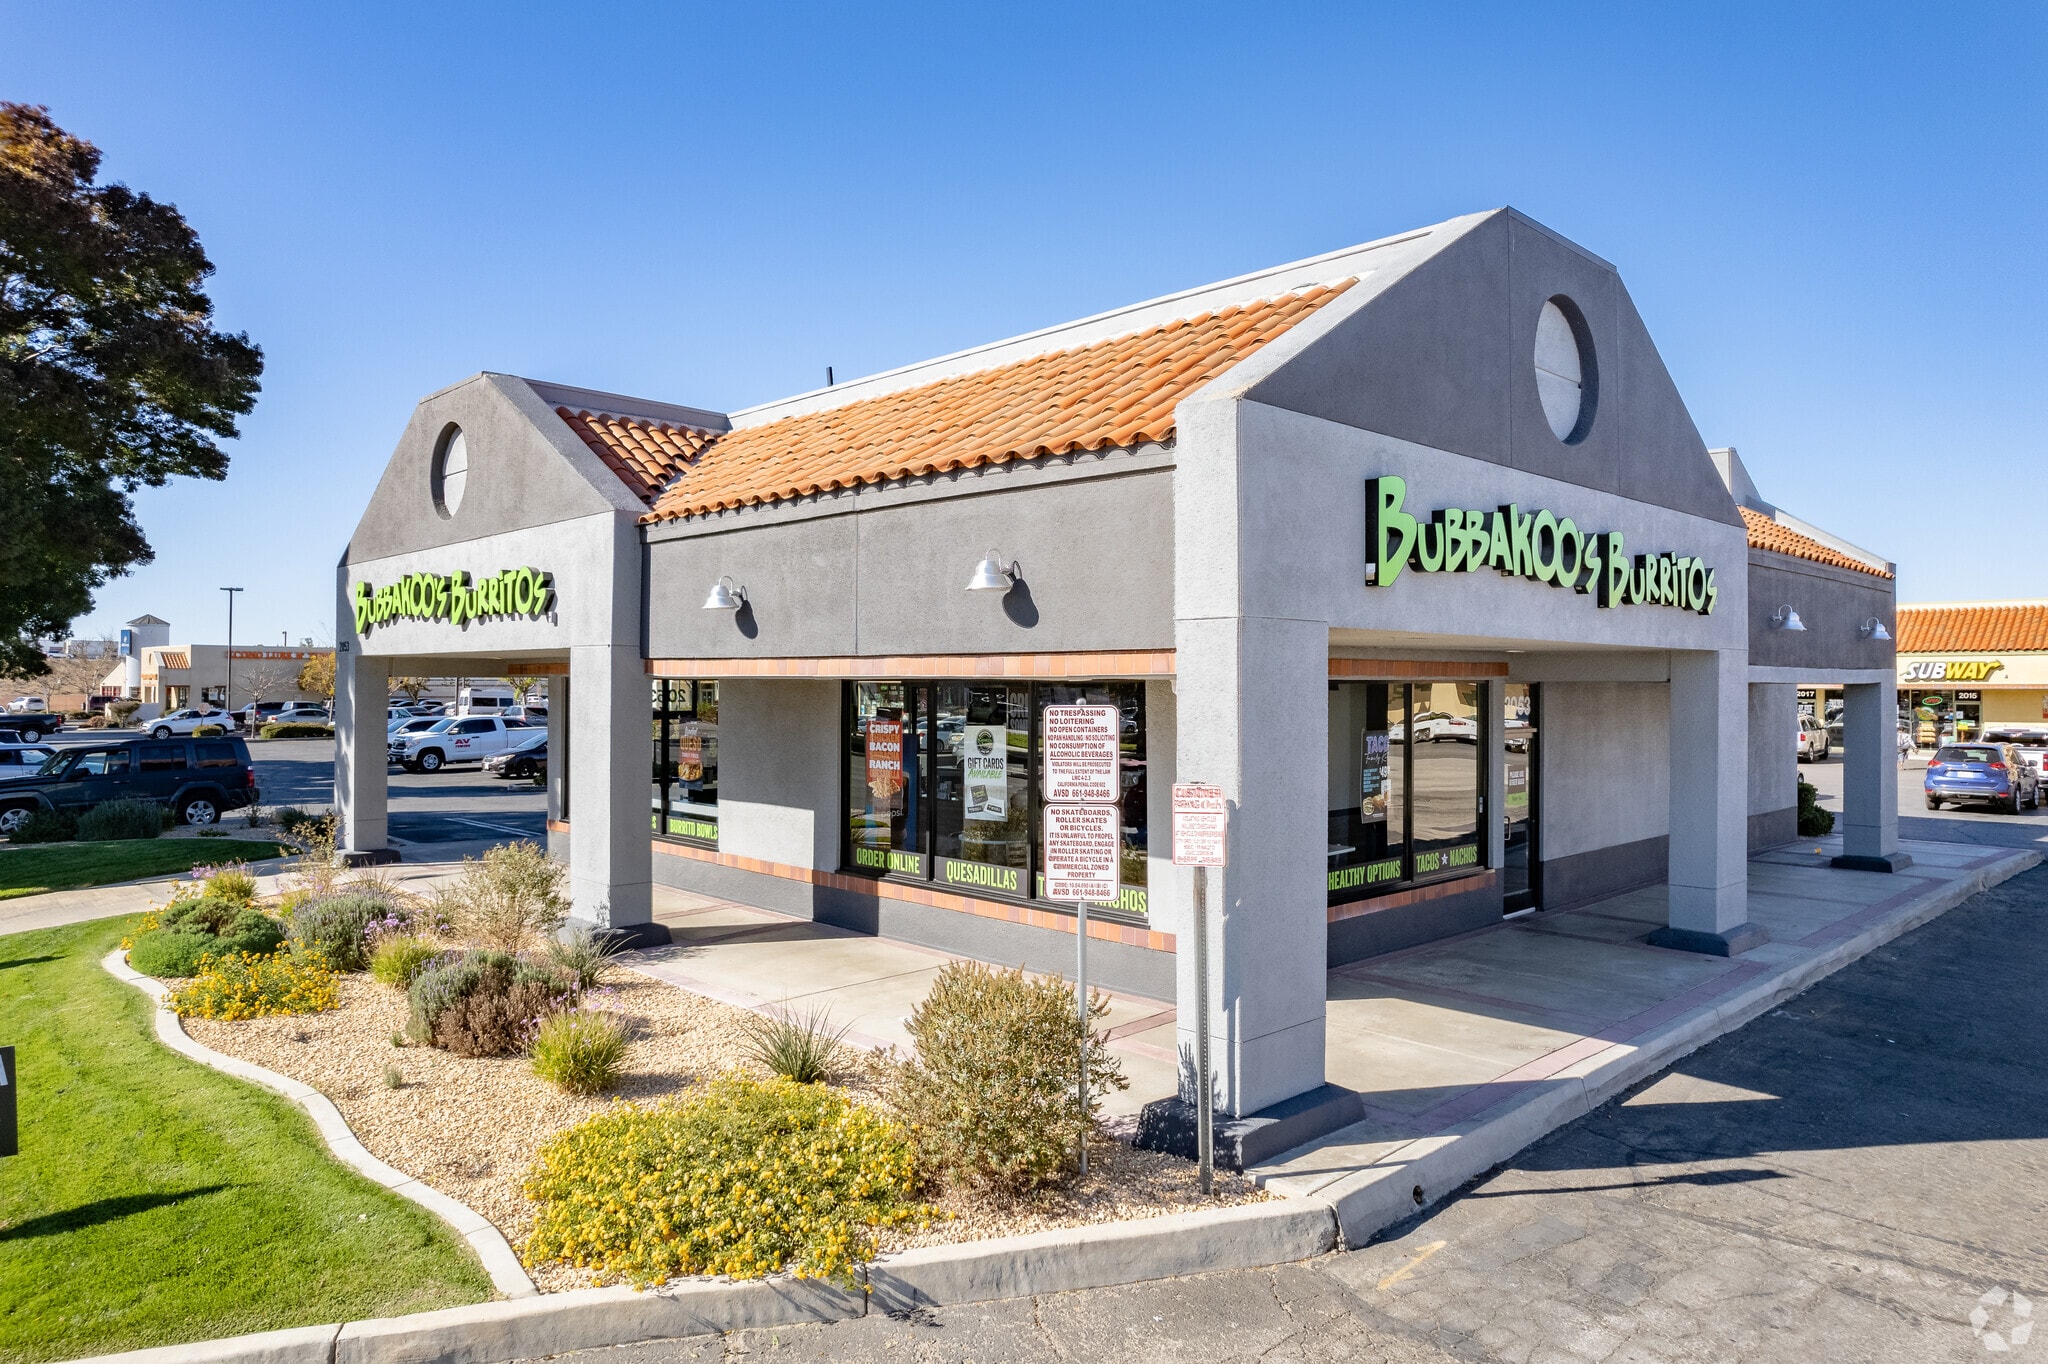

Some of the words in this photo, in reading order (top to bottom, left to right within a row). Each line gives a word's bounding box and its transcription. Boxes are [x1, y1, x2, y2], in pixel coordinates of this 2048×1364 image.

[1377, 475, 1601, 594] BUBBAKOO'S
[1607, 531, 1718, 615] BURRITOS
[355, 571, 449, 634] BUBBAKOO'S
[451, 565, 547, 625] BURRITOS
[1902, 661, 2001, 680] SUBWAY
[1049, 709, 1059, 717] NO
[1060, 709, 1106, 717] TRESPASSING
[869, 724, 900, 734] CRISPY
[869, 741, 900, 752] BACON
[1049, 742, 1058, 750] NO
[1058, 742, 1098, 750] CONSUMPTION
[1098, 742, 1106, 750] OF
[1049, 750, 1081, 758] ALCOHOLIC
[1081, 750, 1113, 758] BEVERAGES
[869, 759, 900, 770] RANCH
[967, 757, 982, 769] GIFT
[983, 757, 1004, 770] CARDS
[967, 768, 1003, 779] AVAILABLE
[1053, 789, 1070, 797] AVSD
[1072, 789, 1110, 798] 661-948-8466
[1050, 808, 1061, 816] NO
[1061, 808, 1113, 817] SKATEBOARDS,
[1081, 816, 1108, 824] SKATES
[669, 818, 695, 836] BURRITO
[696, 822, 718, 840] BOWLS
[1069, 824, 1104, 832] BICYCLES.
[1104, 848, 1113, 856] OR
[856, 847, 885, 869] ORDER
[887, 852, 920, 874] ONLINE
[1416, 852, 1440, 873] TACOS
[1449, 845, 1478, 867] NACHOS
[1053, 863, 1090, 871] COMMERCIAL
[1090, 863, 1110, 871] ZONED
[946, 860, 1017, 891] QUESADILLAS
[1067, 871, 1096, 879] PROPERTY
[1328, 866, 1365, 891] HEALTHY
[1366, 859, 1401, 883] OPTIONS
[1052, 888, 1070, 896] AVSD
[1072, 888, 1111, 897] 661-948-8466
